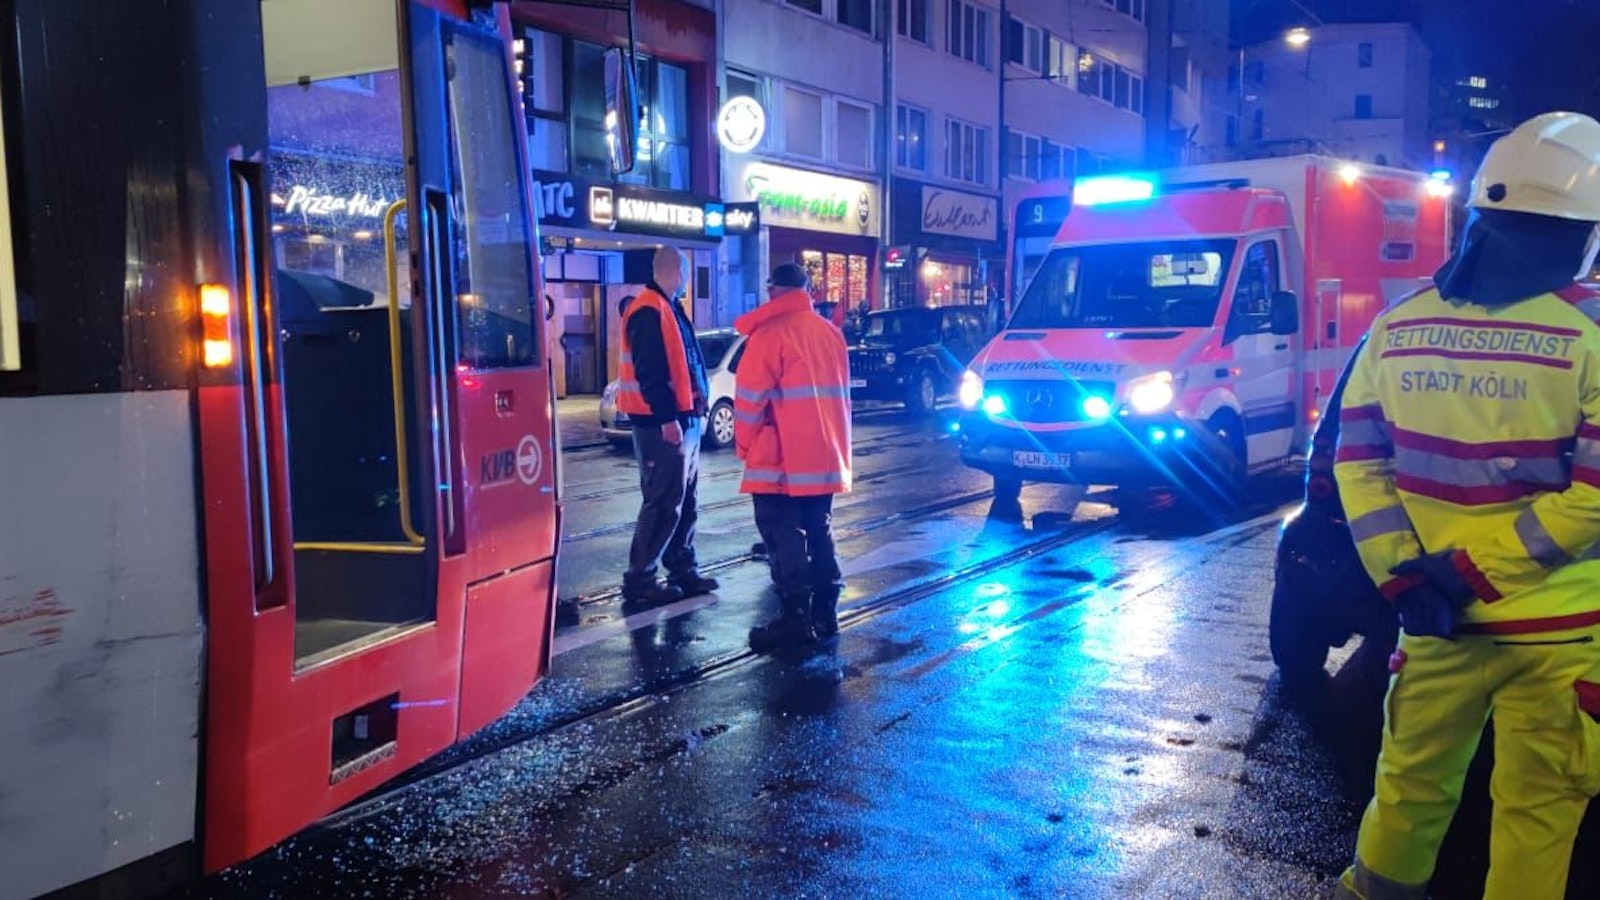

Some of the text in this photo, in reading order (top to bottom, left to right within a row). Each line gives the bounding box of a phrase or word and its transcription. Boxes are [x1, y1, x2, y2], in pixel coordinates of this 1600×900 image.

[286, 184, 387, 217] Pizza Hut
[1034, 204, 1043, 223] 9
[725, 208, 753, 229] sky
[1387, 326, 1576, 357] RETTUNGSDIENST
[1401, 370, 1528, 399] STADT KÖLN
